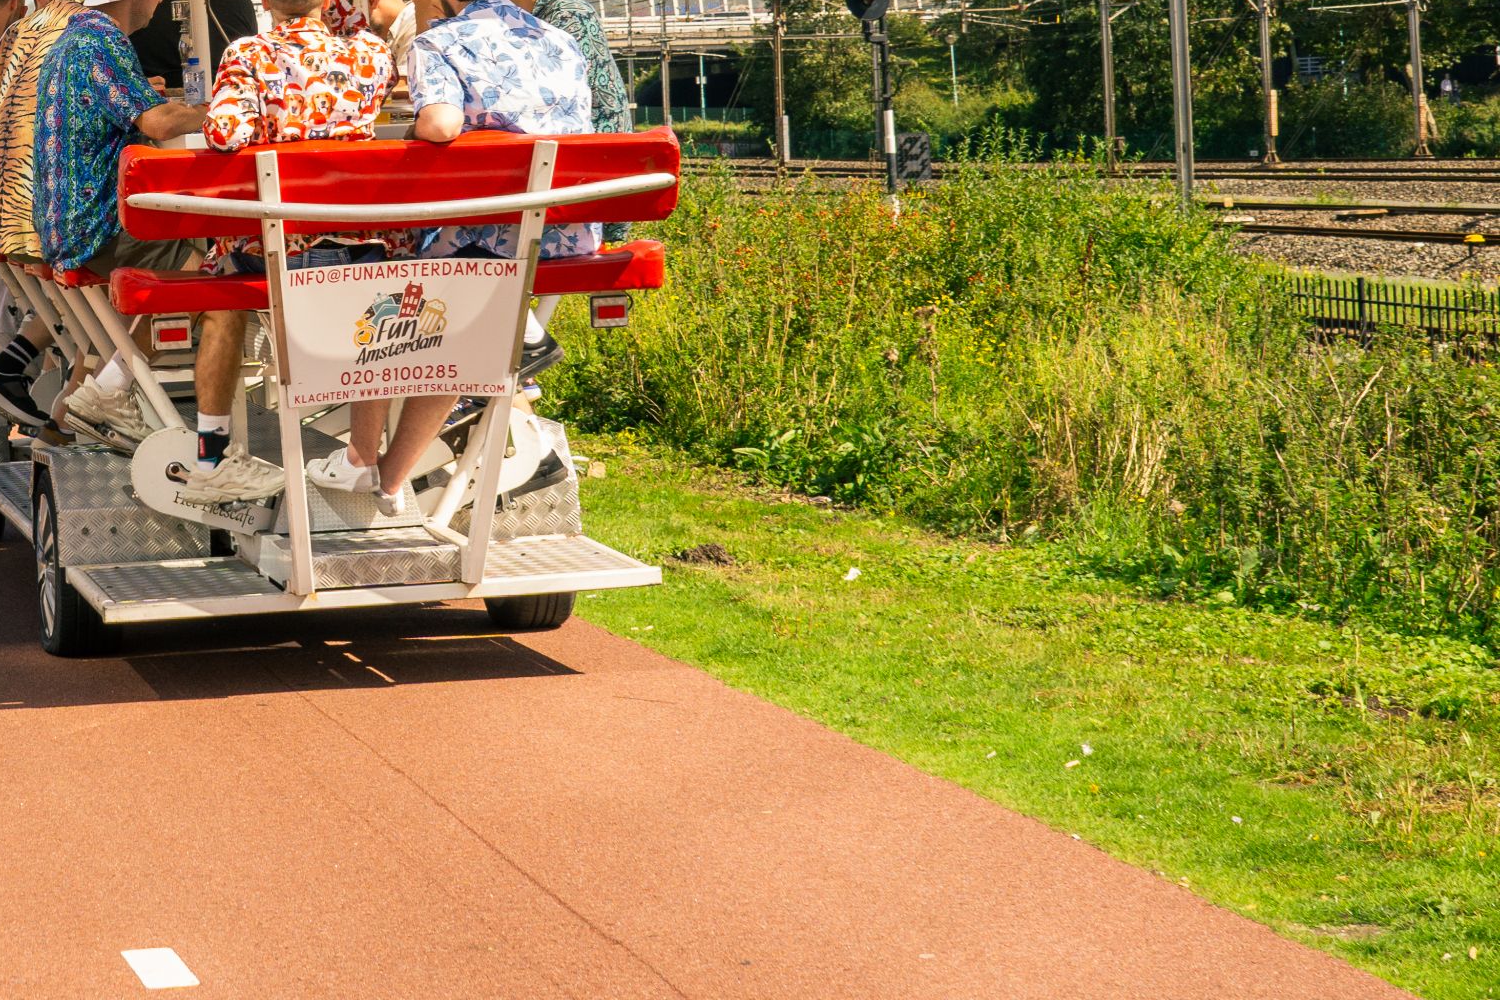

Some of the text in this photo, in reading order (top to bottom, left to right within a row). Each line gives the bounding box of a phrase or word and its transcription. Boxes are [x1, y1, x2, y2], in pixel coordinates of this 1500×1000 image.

[290, 262, 518, 287] INFO@FUNAMSTERDAM.COM
[376, 317, 418, 343] Fun
[355, 334, 443, 366] Amsterdam
[340, 365, 458, 386] 020-8100285
[294, 384, 506, 404] KLACHTEN? WWW.BIERFIETSKLACHT.COM
